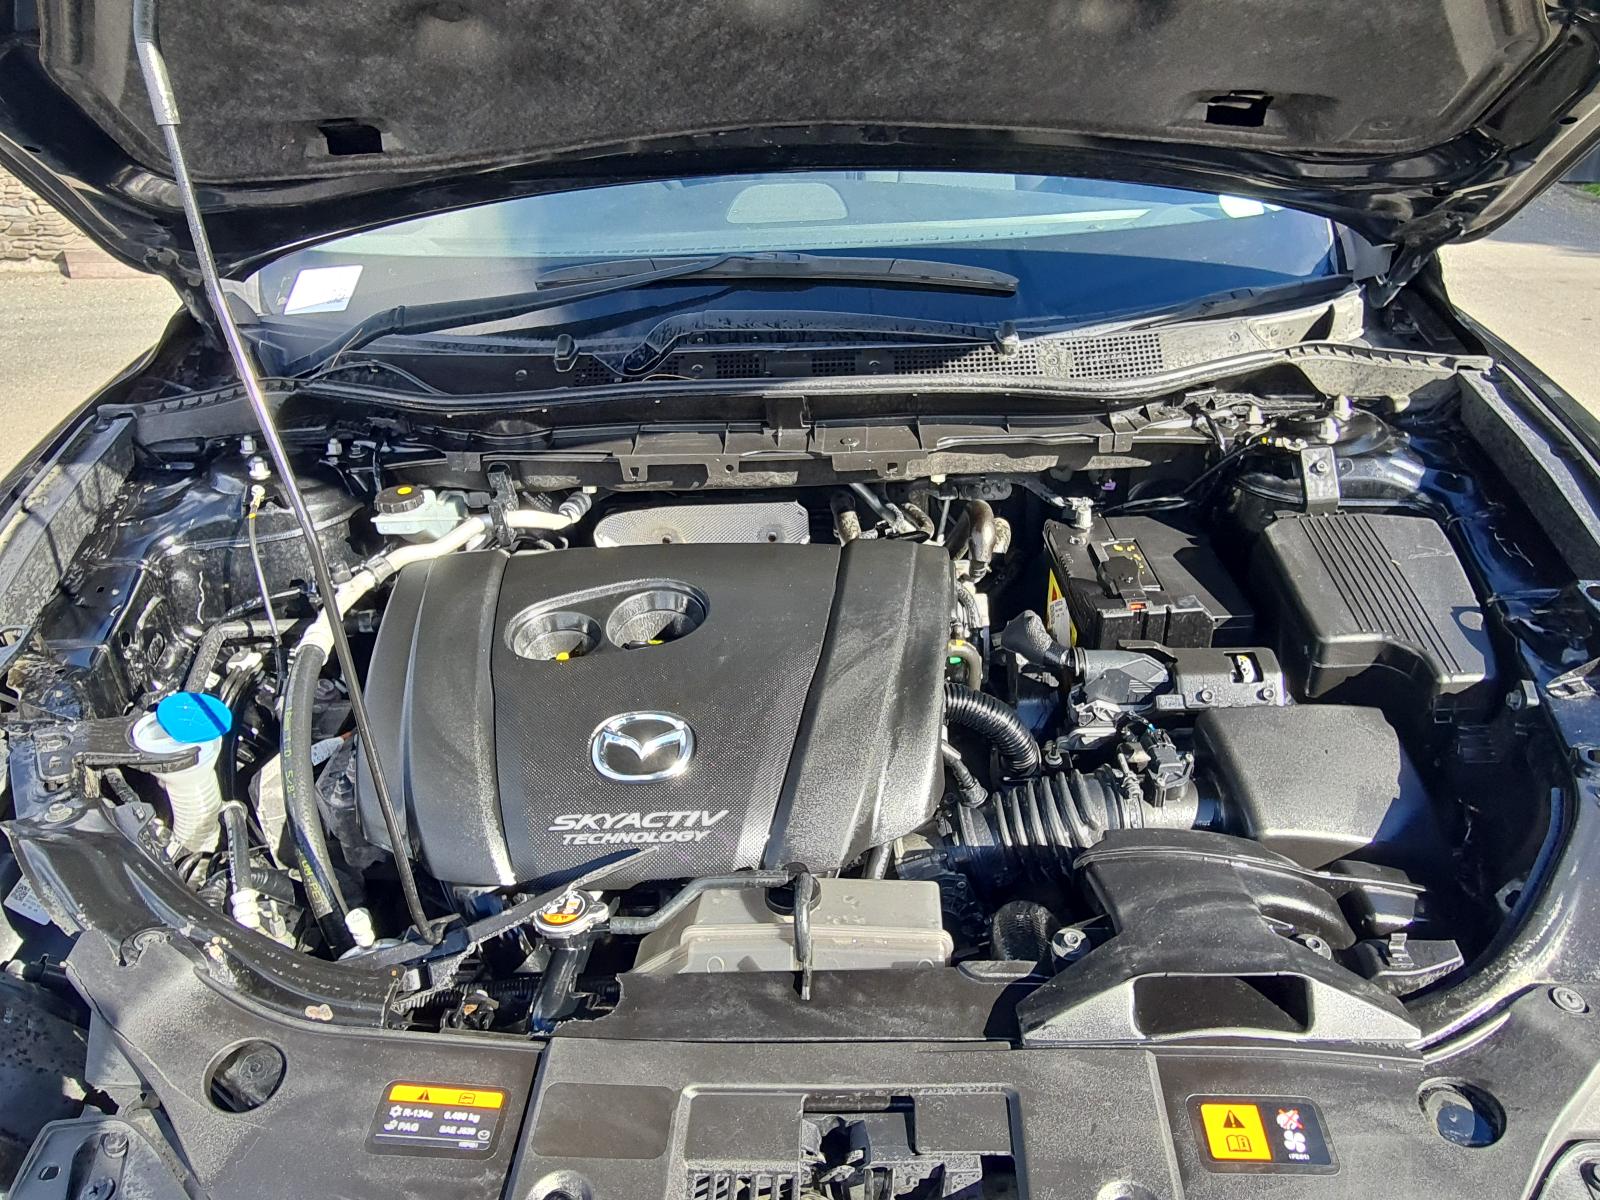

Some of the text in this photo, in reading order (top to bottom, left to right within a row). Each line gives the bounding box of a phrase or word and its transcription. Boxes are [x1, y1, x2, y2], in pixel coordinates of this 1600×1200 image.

[548, 809, 730, 832] SKYACTIV
[562, 830, 712, 846] TECHNOLOGY
[402, 1107, 434, 1119] R-134a
[468, 1112, 481, 1123] kg
